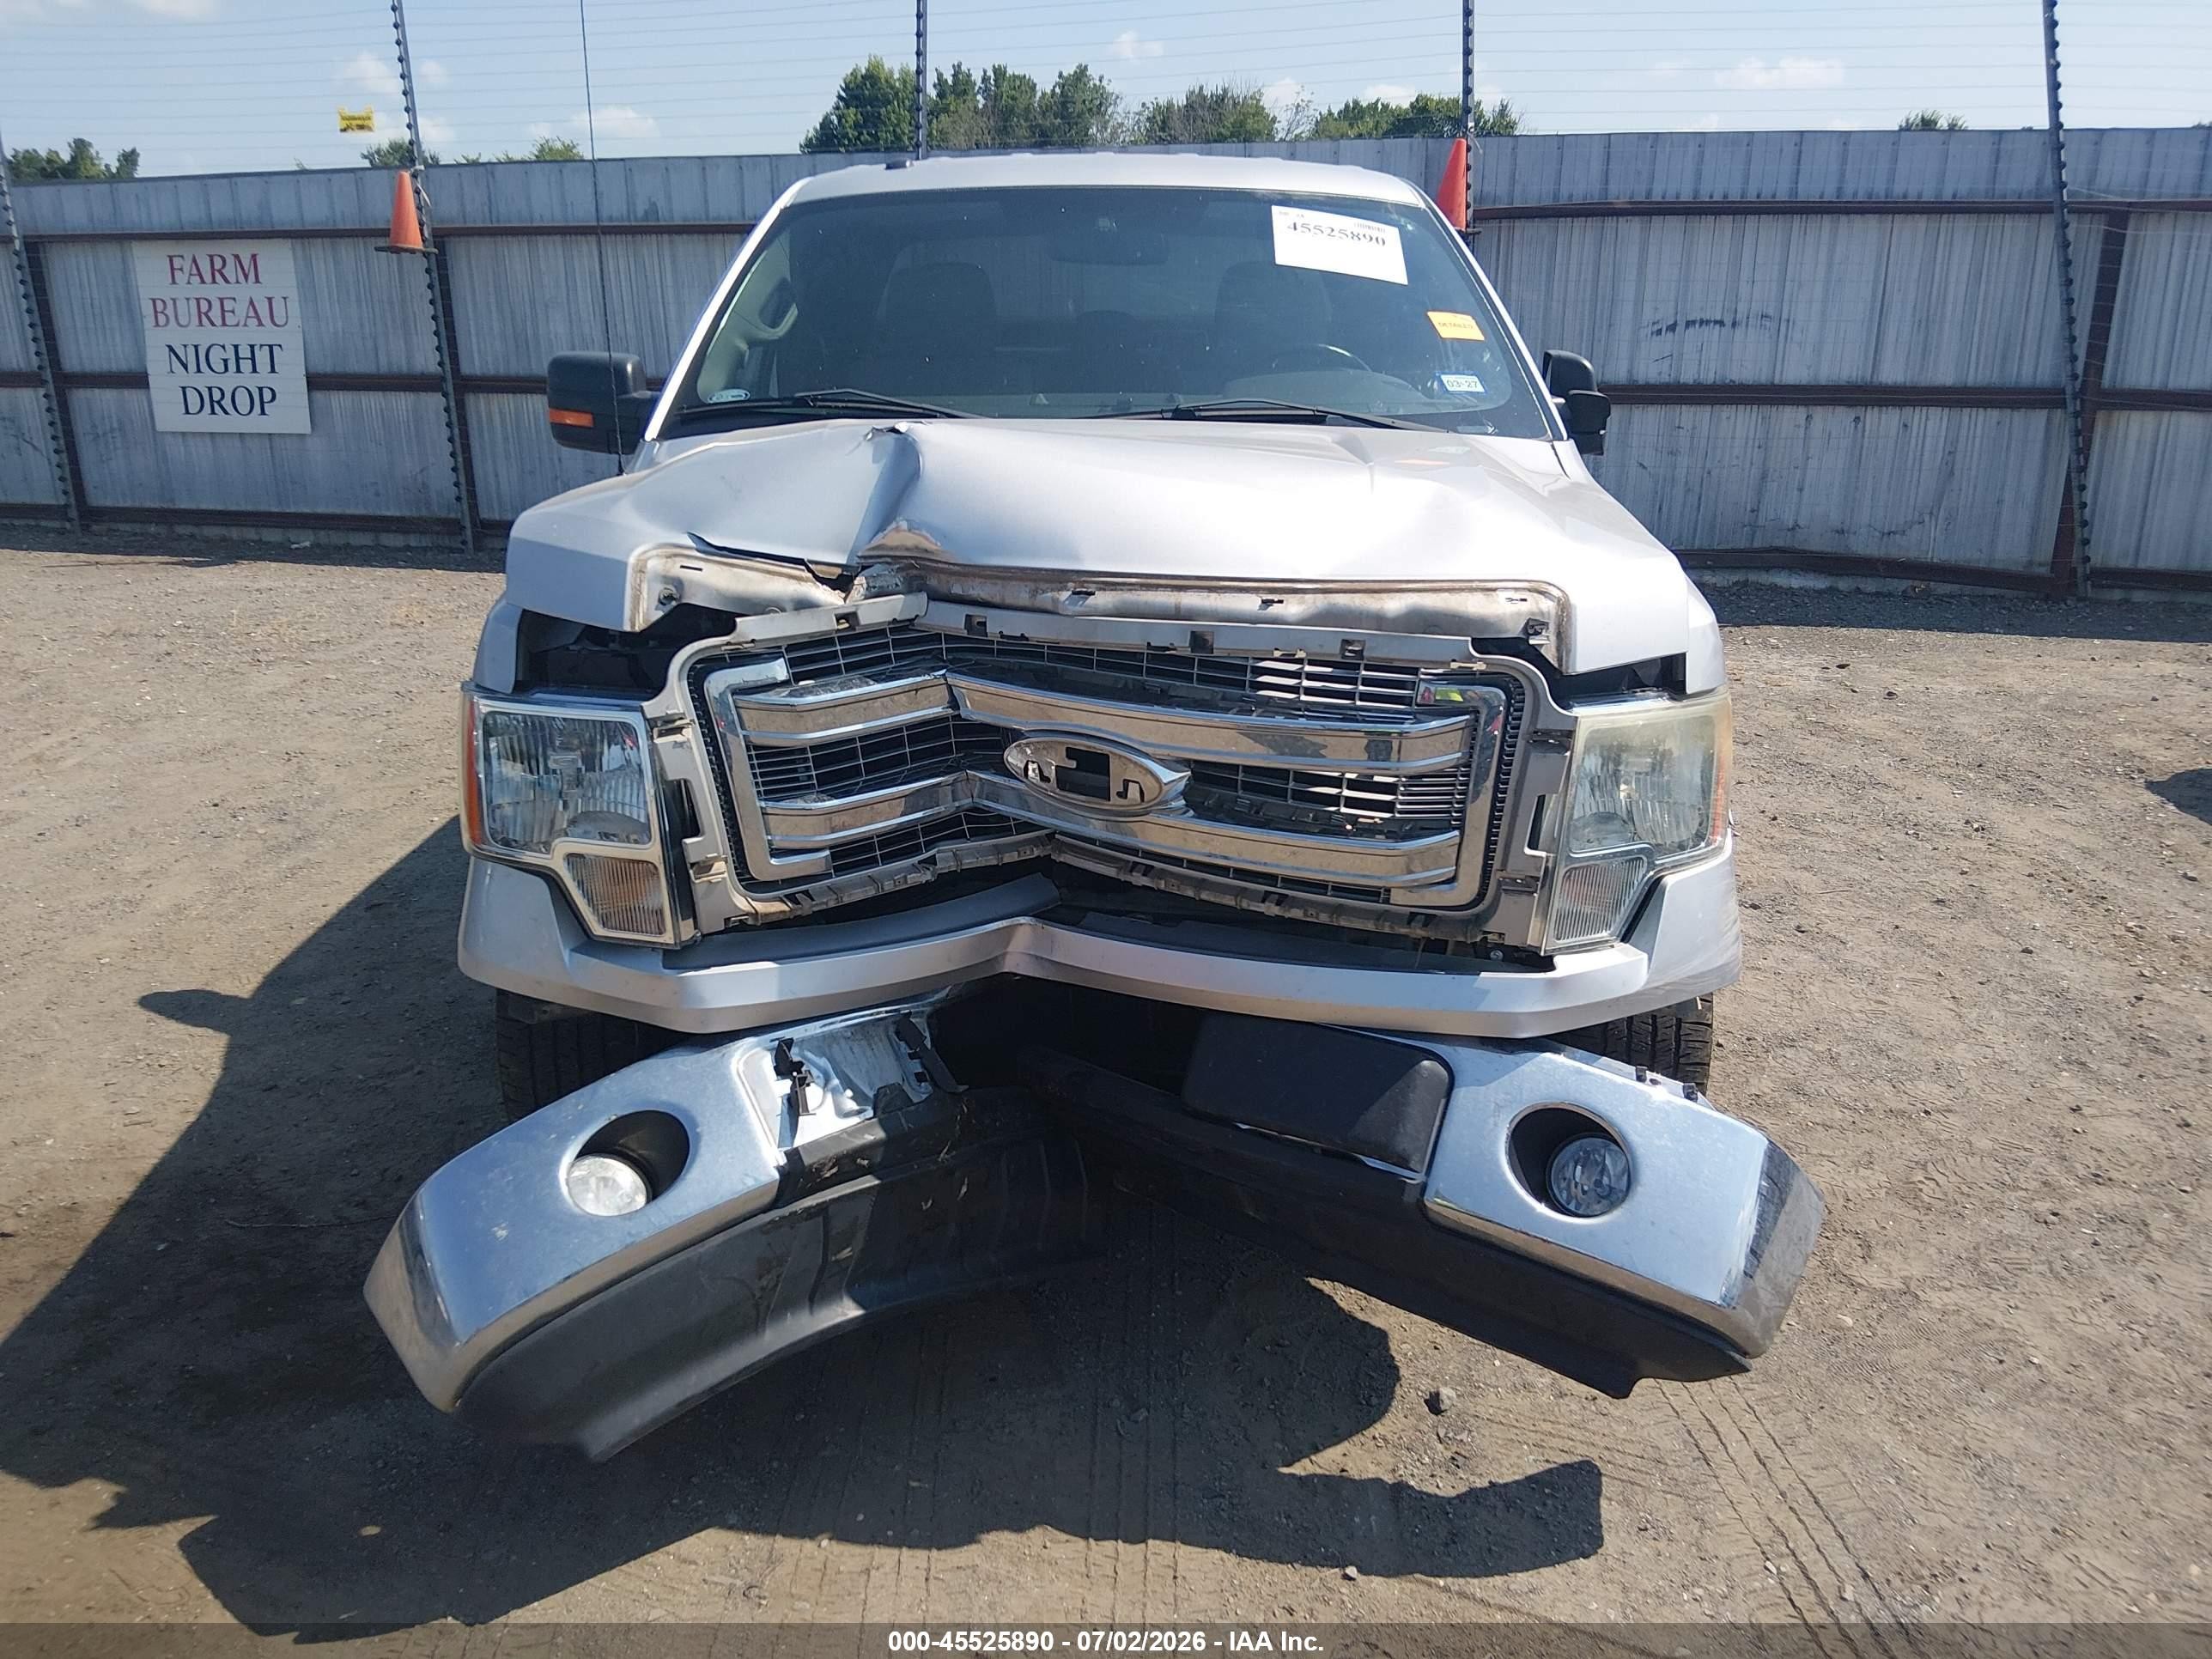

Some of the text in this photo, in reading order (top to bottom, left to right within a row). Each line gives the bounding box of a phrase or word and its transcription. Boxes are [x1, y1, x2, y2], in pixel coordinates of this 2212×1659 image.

[1287, 222, 1386, 246] 45525890
[167, 253, 262, 284] FARM
[149, 296, 289, 328] BUREAU
[165, 343, 283, 374] NIGHT
[1447, 379, 1478, 389] 03-27
[179, 385, 276, 416] DROP
